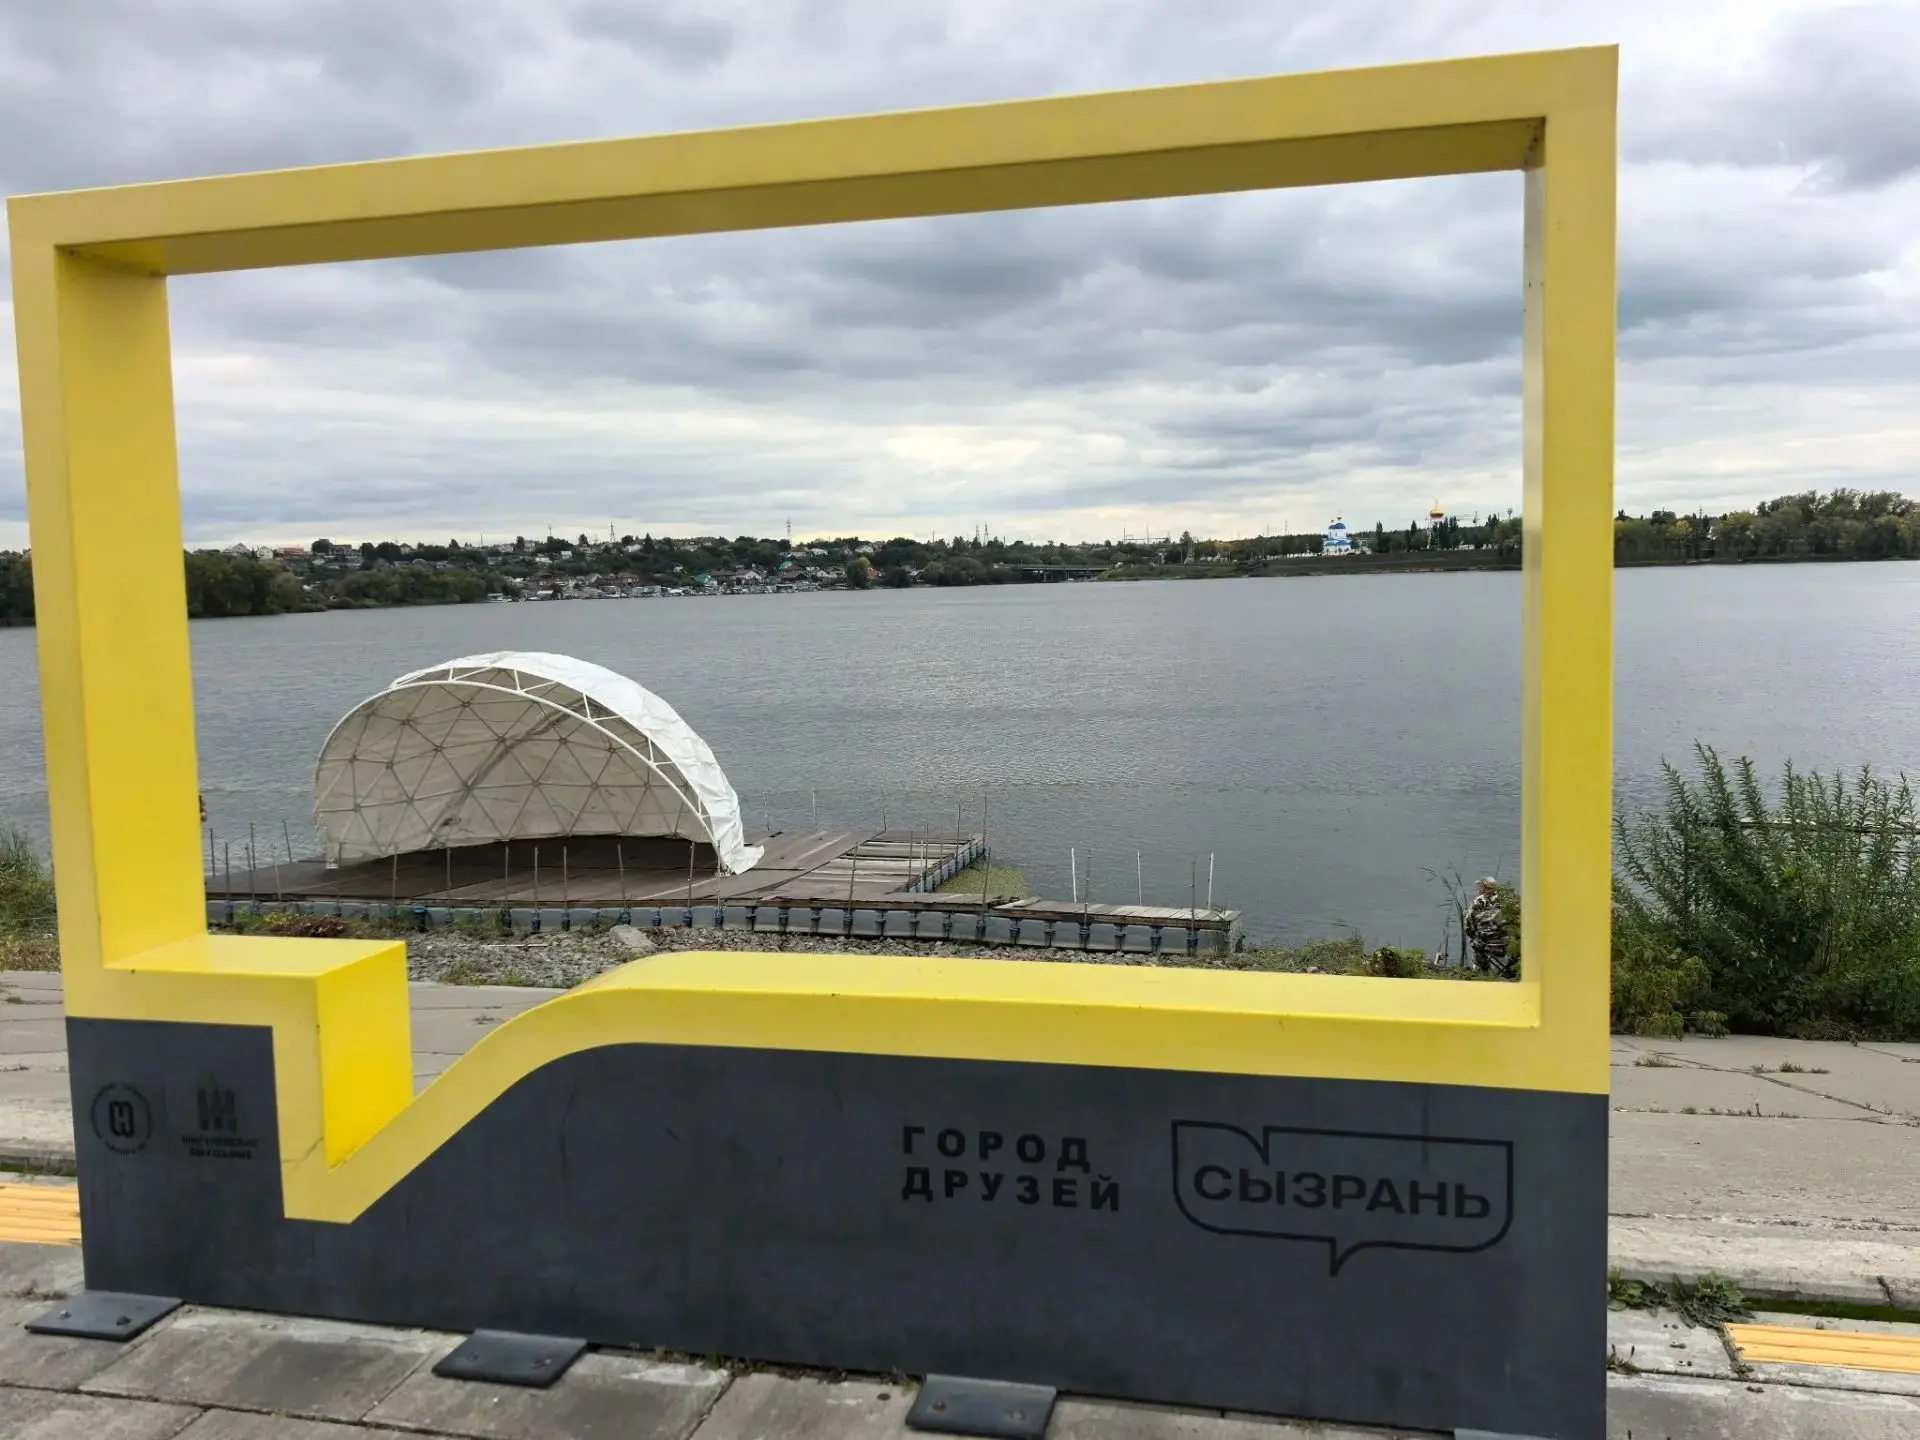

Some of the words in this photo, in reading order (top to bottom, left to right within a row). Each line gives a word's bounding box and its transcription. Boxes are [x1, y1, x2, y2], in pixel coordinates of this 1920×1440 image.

[903, 1124, 1092, 1174] ГОРОД
[901, 1167, 1121, 1214] ДРУЗЕЙ
[1193, 1164, 1491, 1219] СЫЗРАНЬ
